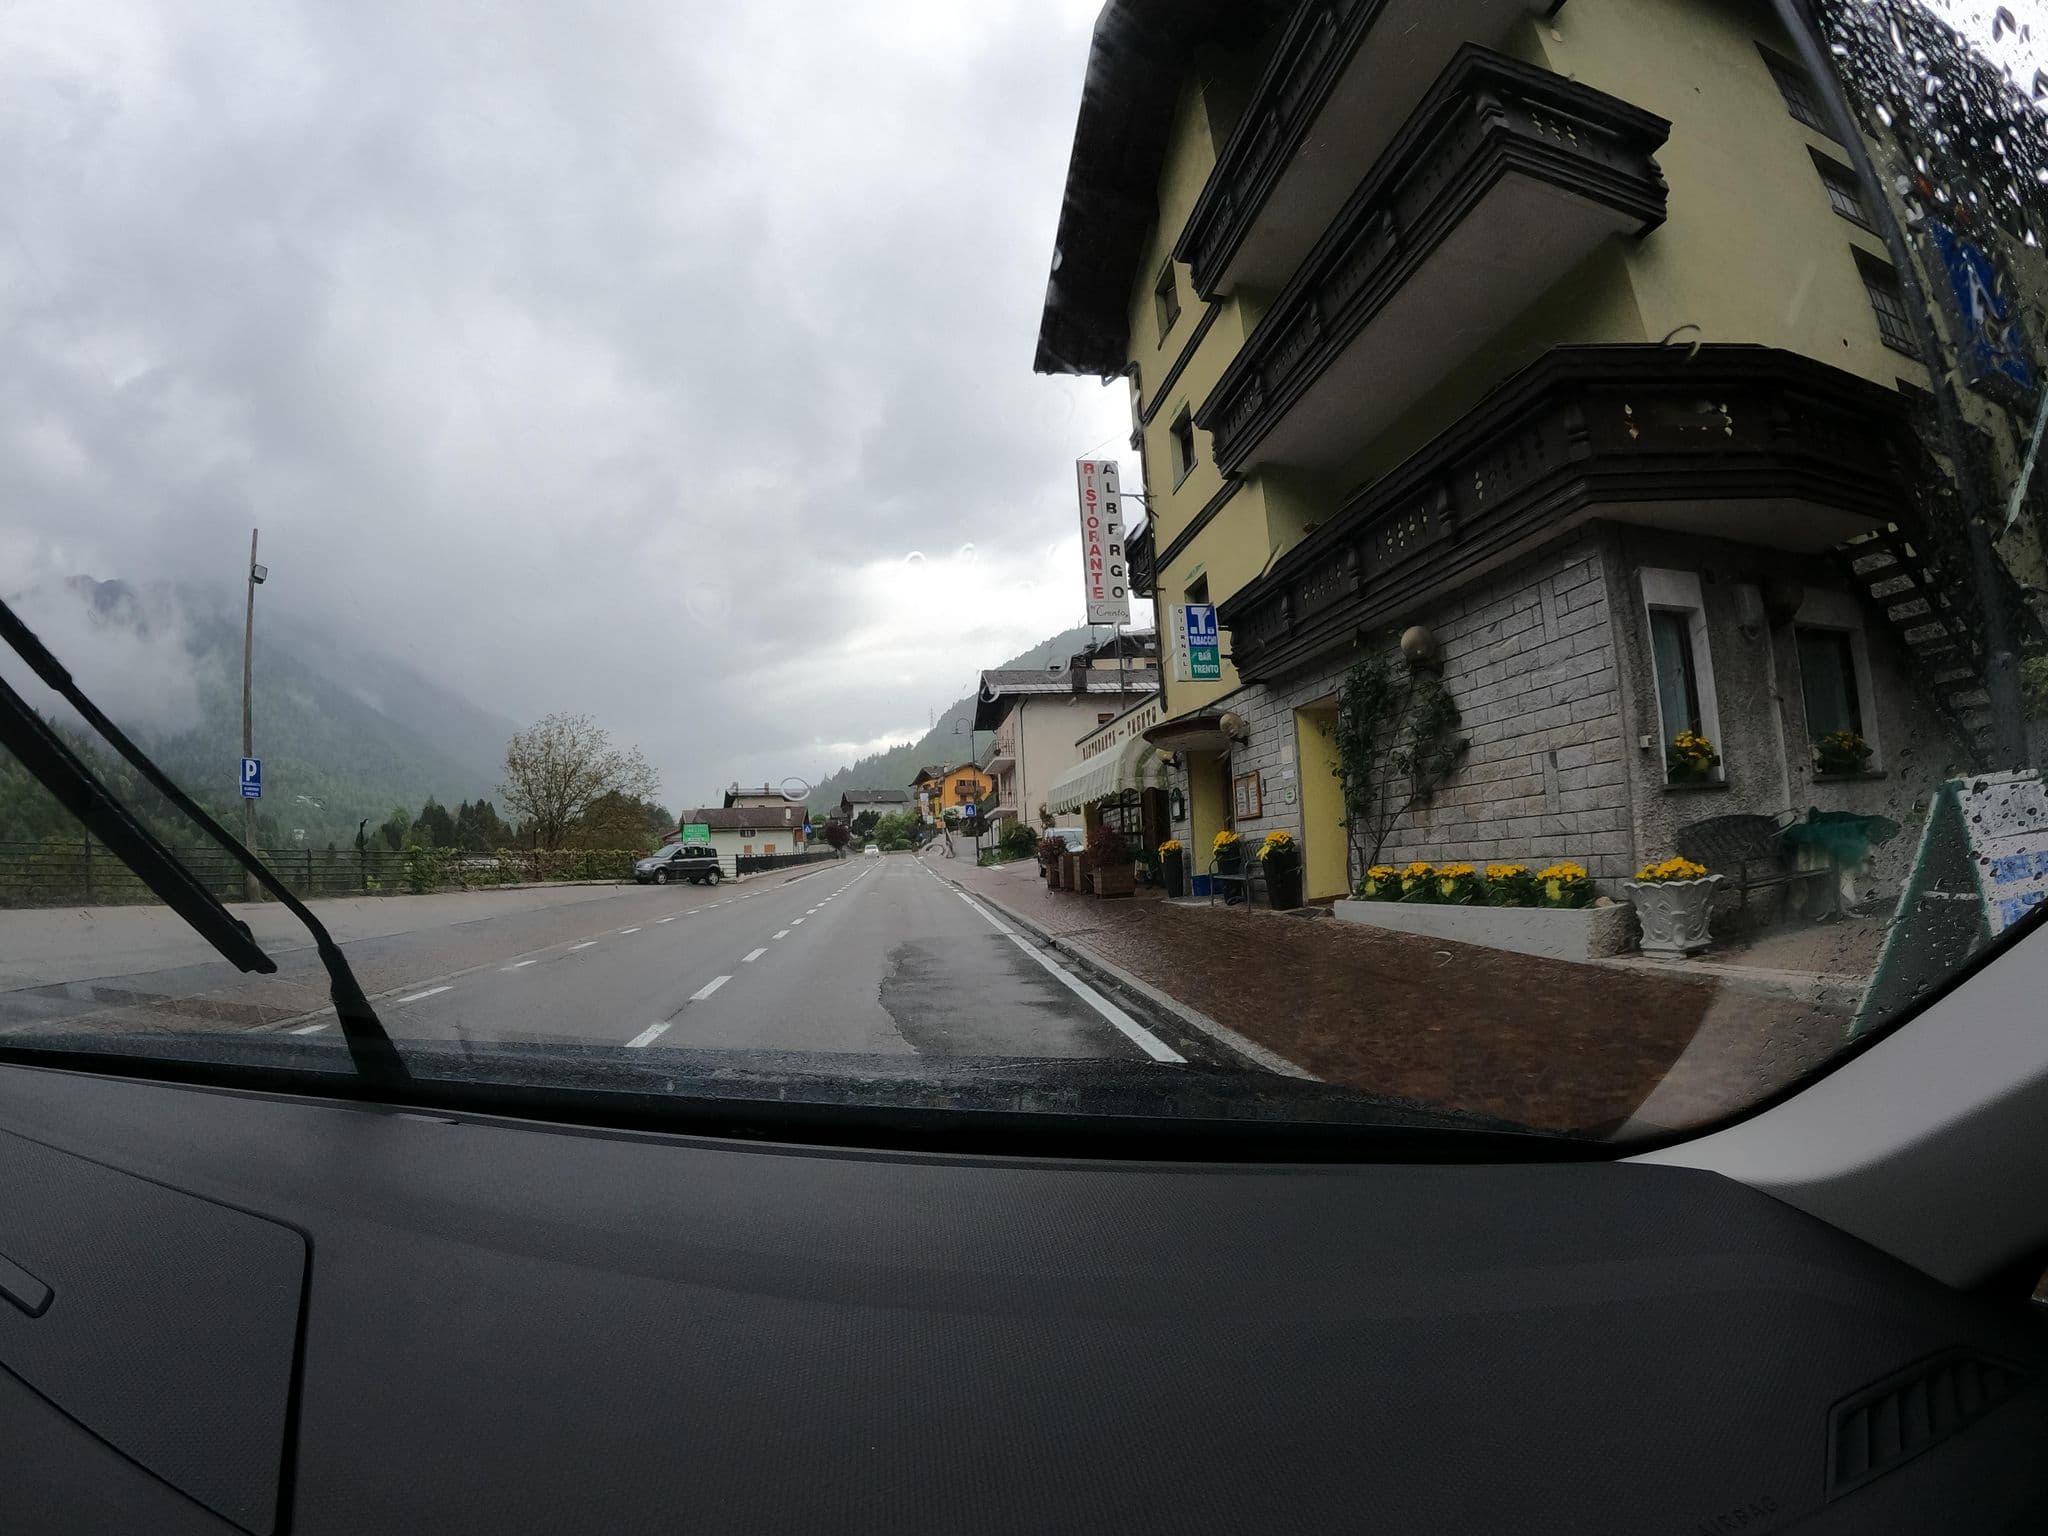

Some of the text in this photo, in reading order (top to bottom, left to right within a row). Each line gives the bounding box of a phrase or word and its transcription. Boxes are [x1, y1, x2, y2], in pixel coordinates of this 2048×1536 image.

[1083, 463, 1104, 600] RISTORANTE
[1178, 608, 1188, 675] GIORNALI
[1198, 651, 1211, 660] BAR
[1193, 664, 1218, 674] TRENTO
[246, 760, 257, 781] P
